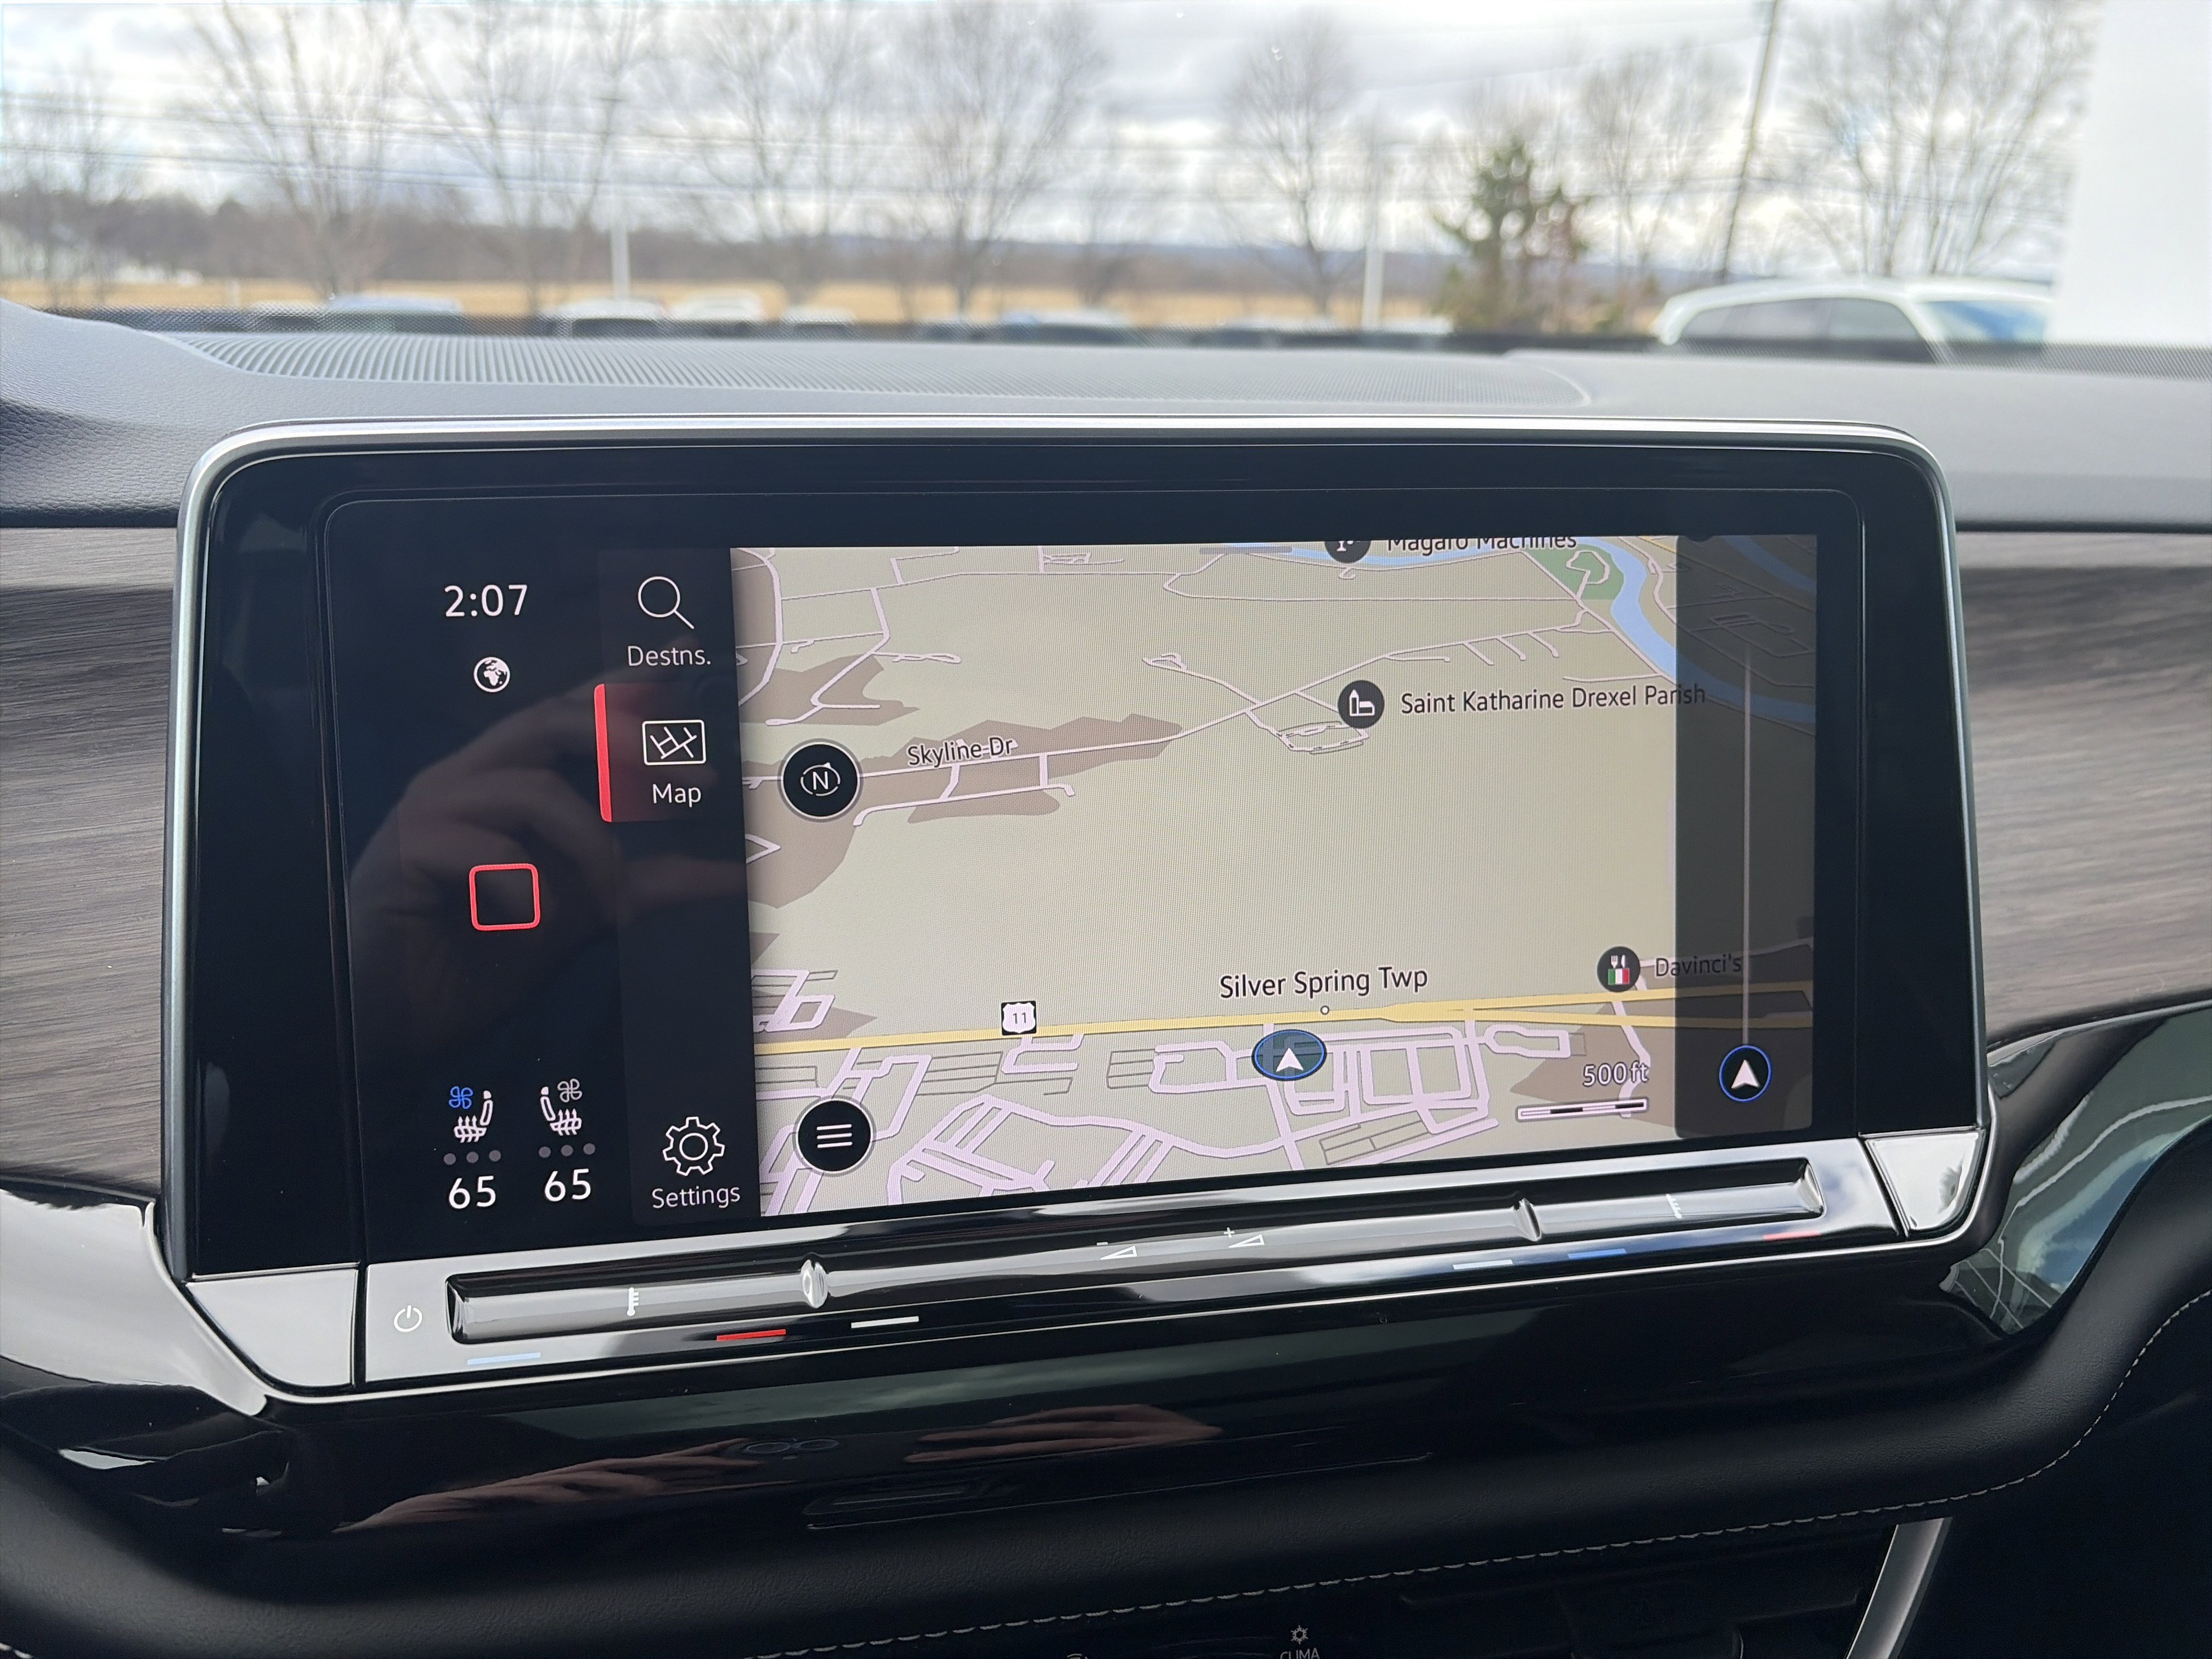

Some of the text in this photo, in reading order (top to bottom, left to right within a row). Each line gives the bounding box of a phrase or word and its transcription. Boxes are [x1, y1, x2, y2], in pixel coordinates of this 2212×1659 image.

[1388, 538, 1469, 556] Magaro
[444, 584, 528, 617] 2:07
[627, 645, 712, 667] Destns.
[1402, 684, 1705, 714] Saint Katharine Drexel Parish
[907, 737, 1013, 768] Skyline Dr
[812, 771, 830, 790] N
[652, 783, 702, 808] Map
[1655, 953, 1741, 977] Davinci's
[1220, 966, 1428, 999] Silver Spring Twp
[1012, 1012, 1028, 1025] 11
[448, 1175, 496, 1210] 65
[544, 1168, 592, 1202] 65
[651, 1185, 741, 1209] Settings
